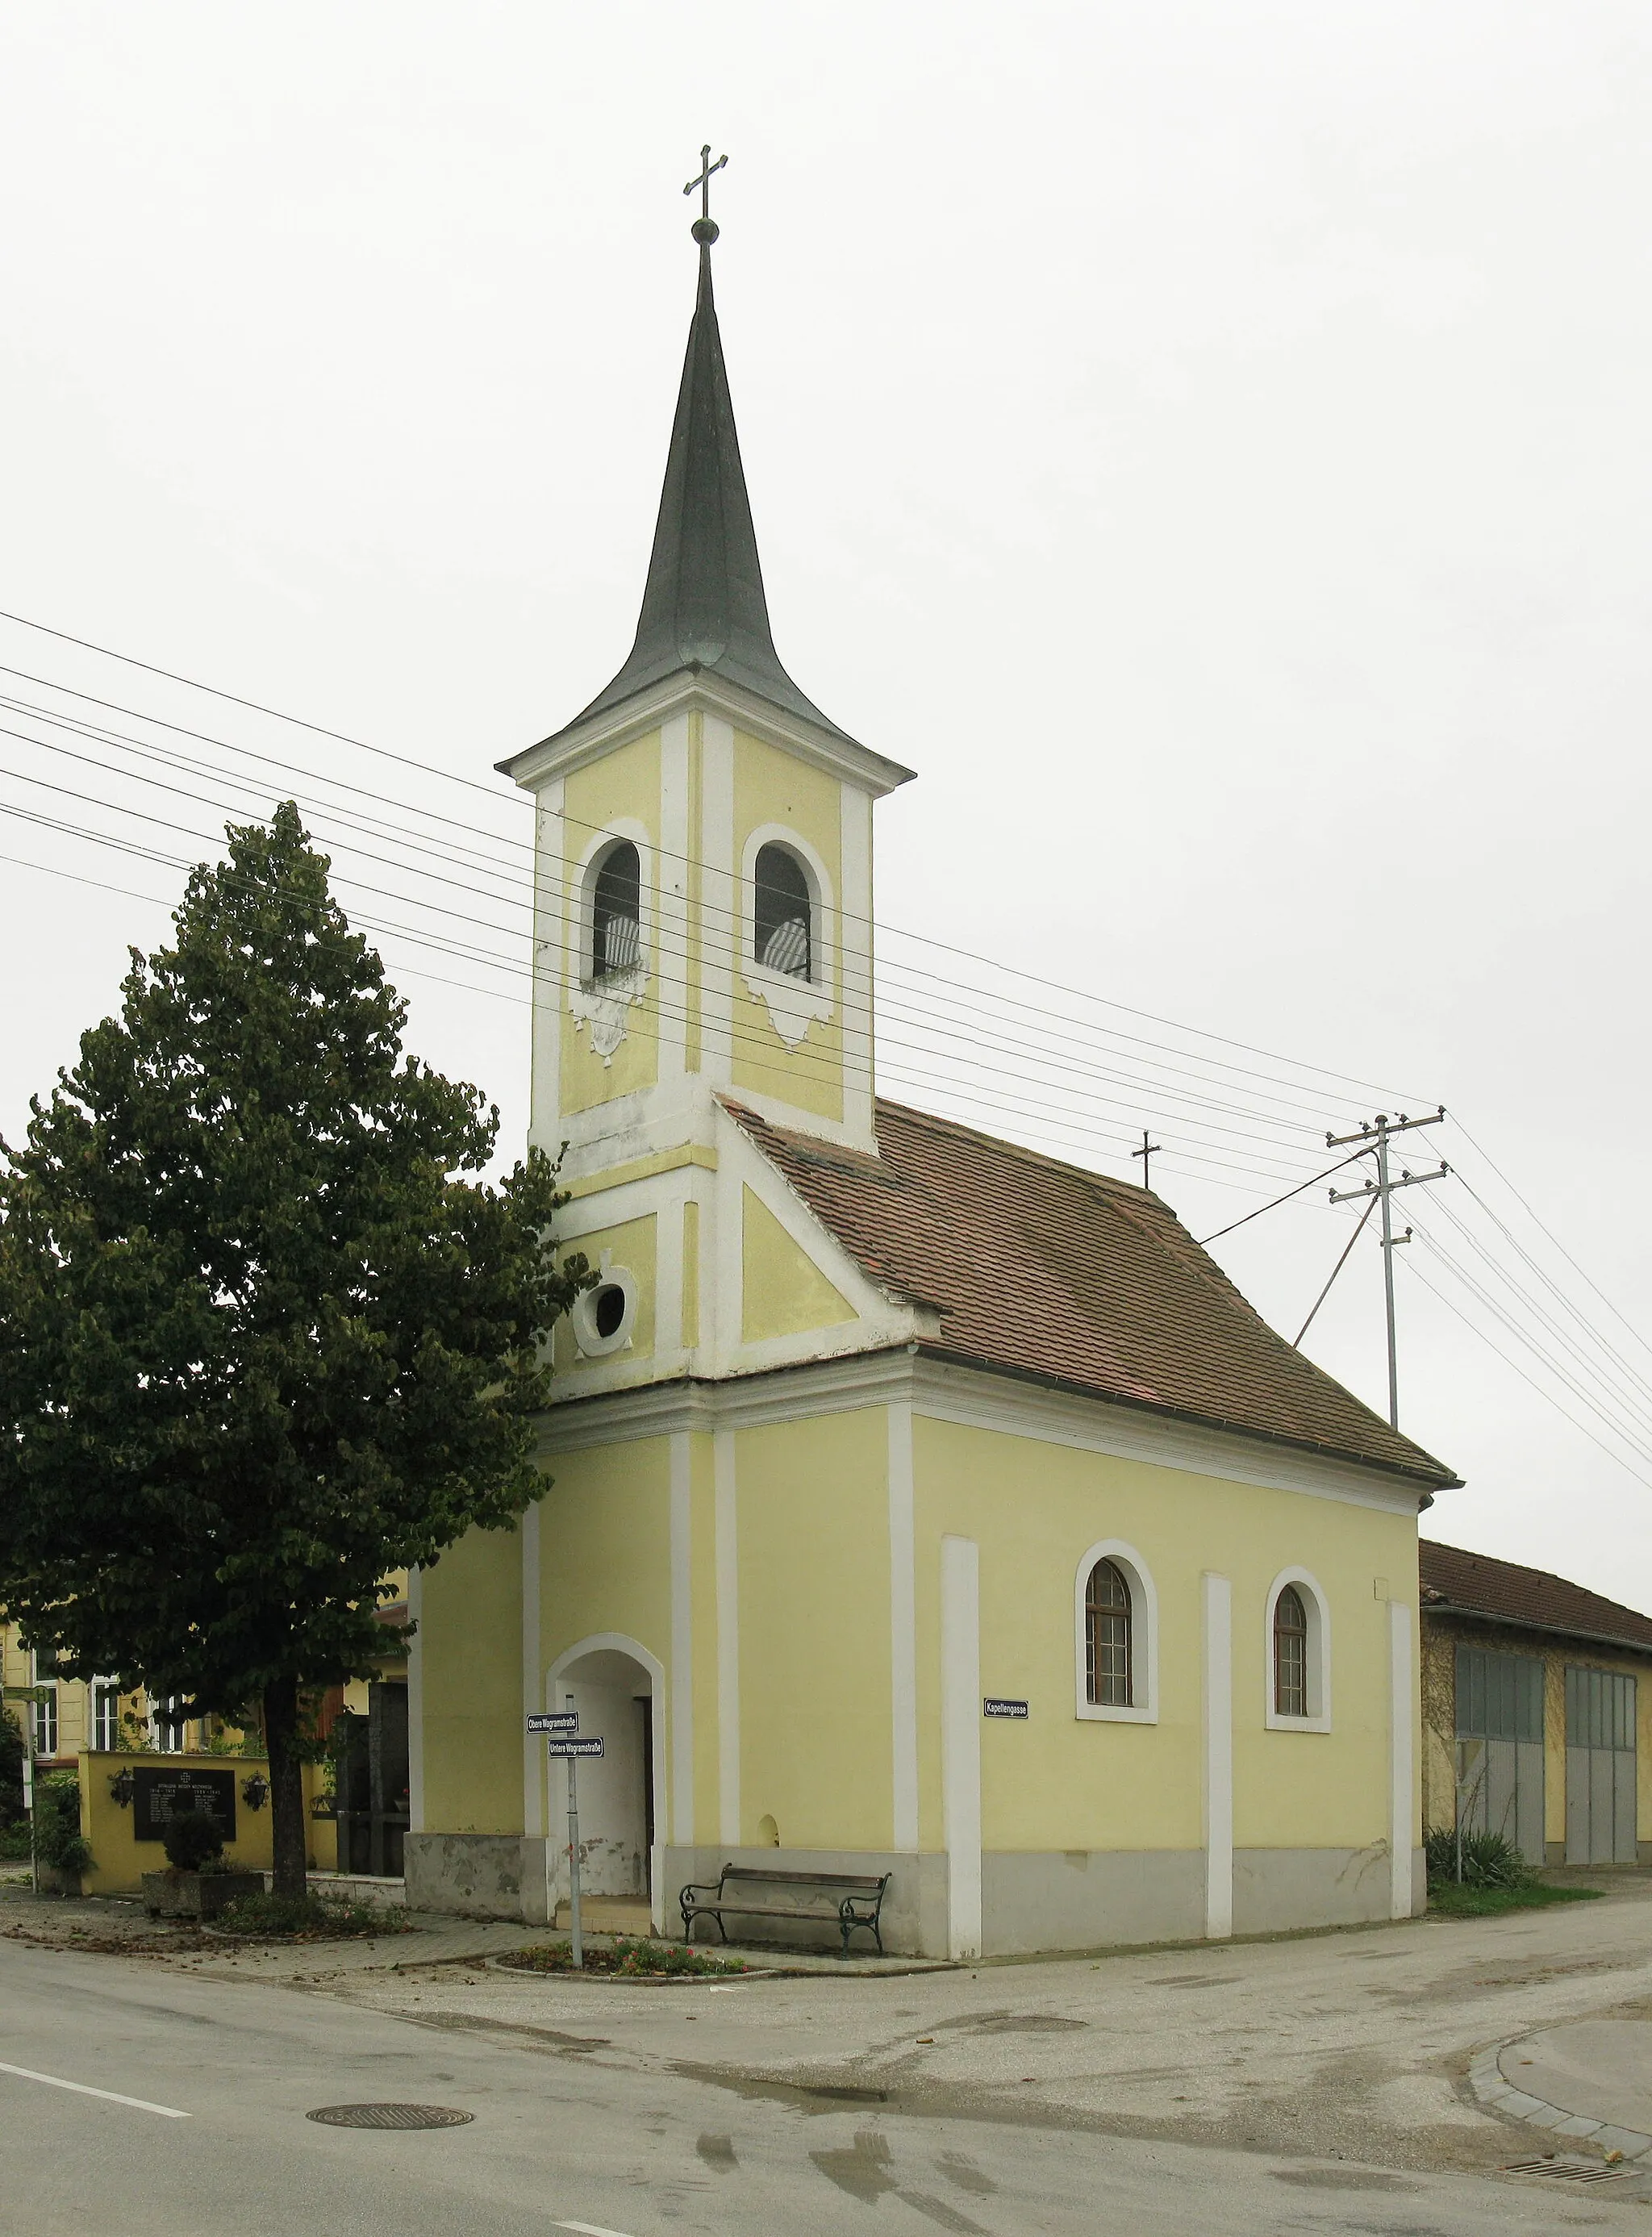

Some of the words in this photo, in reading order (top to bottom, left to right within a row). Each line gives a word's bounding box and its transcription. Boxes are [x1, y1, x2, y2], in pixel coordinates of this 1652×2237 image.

[987, 1702, 1026, 1715] Kapellengasse
[528, 1719, 542, 1729] Obere
[542, 1717, 575, 1730] Wagramstraße
[550, 1744, 566, 1753] Untere
[565, 1742, 601, 1755] Wagramstraße
